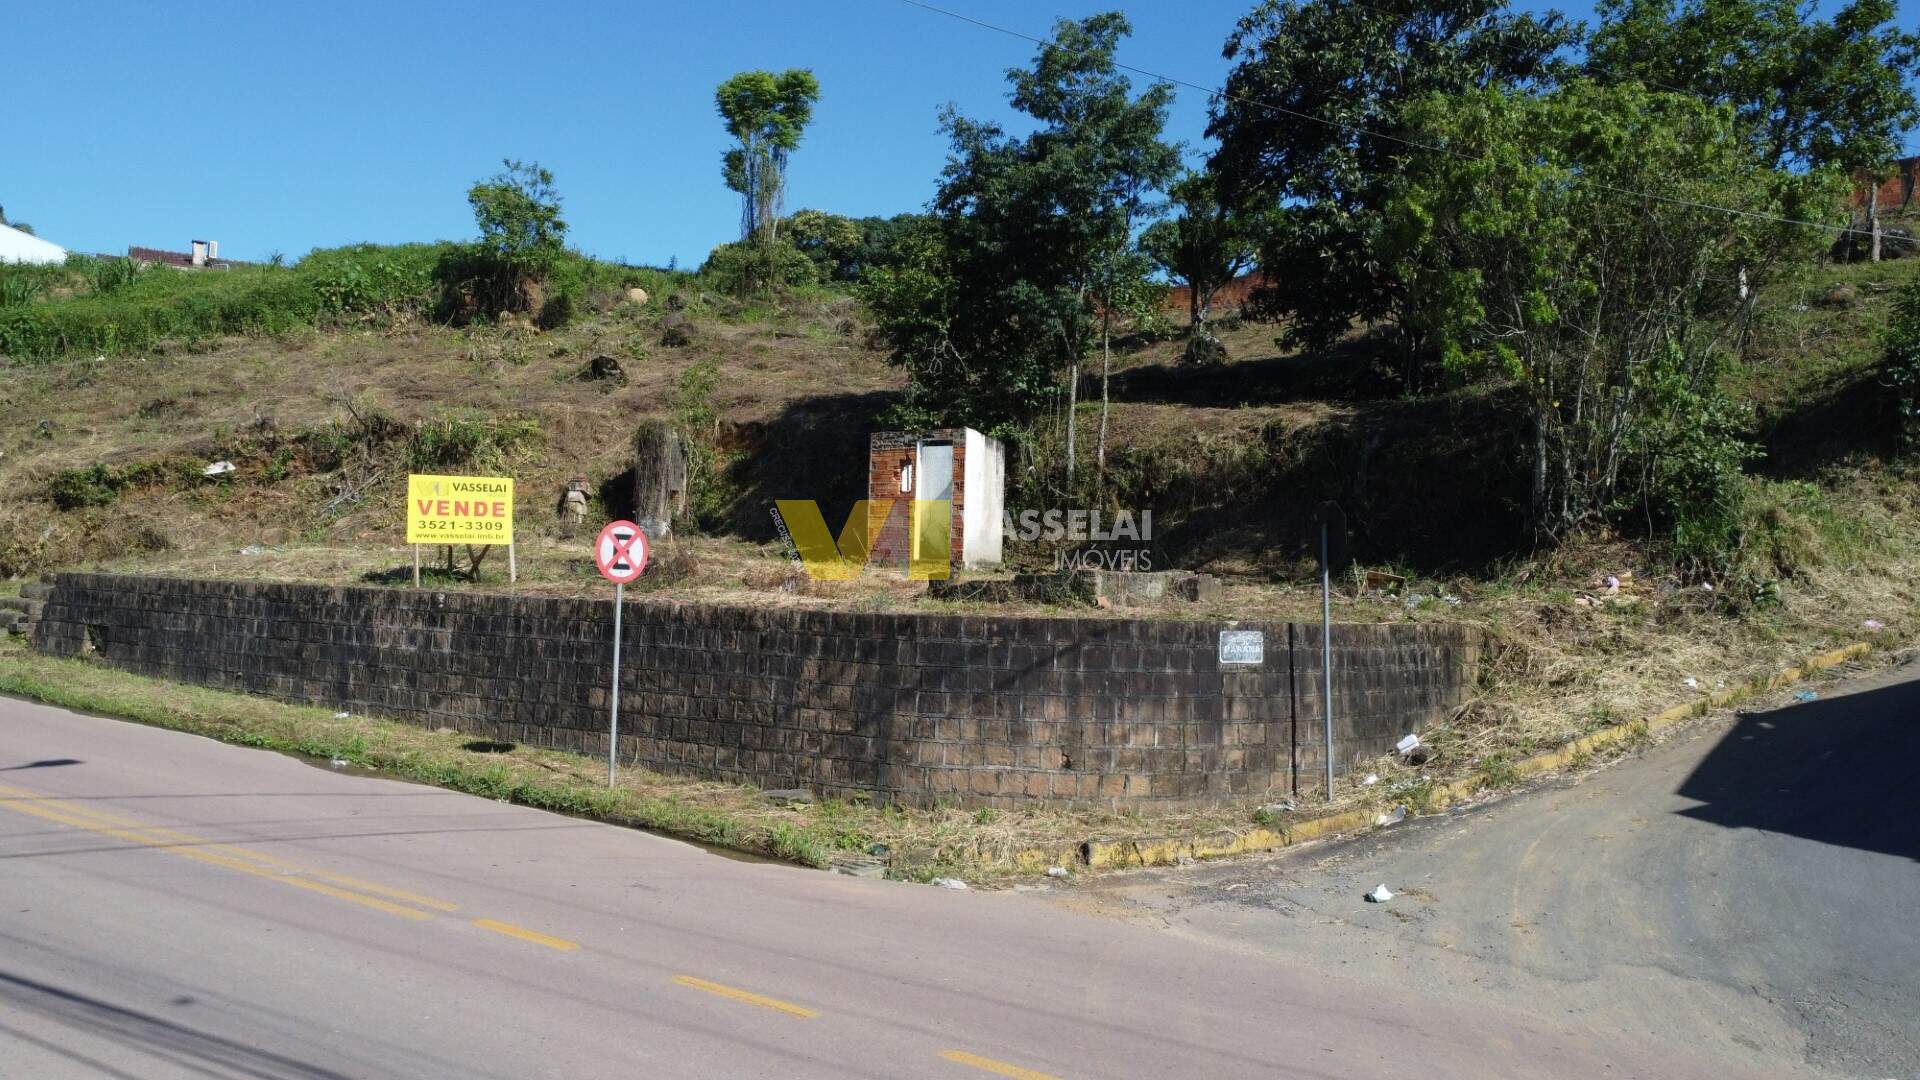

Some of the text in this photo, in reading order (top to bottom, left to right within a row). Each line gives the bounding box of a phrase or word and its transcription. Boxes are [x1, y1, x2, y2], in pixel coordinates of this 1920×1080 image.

[452, 482, 507, 493] VASSELAI
[417, 499, 506, 518] VENDE
[418, 520, 503, 531] 3521-3309
[415, 532, 505, 540] www.vasselai.imb.br
